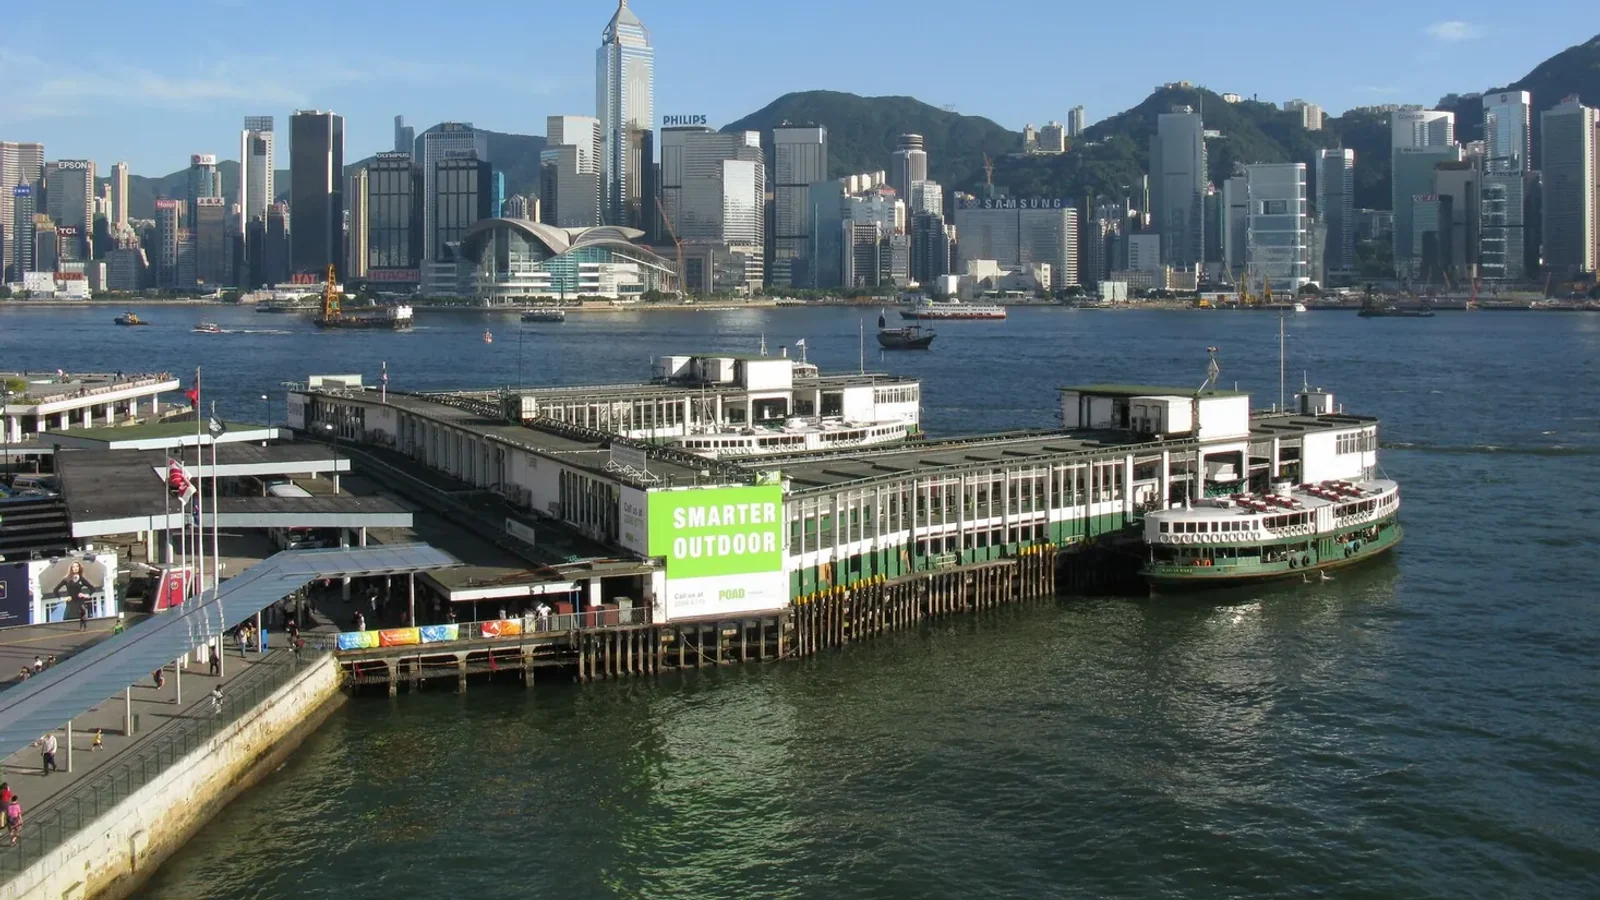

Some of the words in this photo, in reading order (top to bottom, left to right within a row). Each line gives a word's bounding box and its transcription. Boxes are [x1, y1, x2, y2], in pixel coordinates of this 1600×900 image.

[663, 115, 707, 125] PHILIPS
[58, 161, 87, 170] EPSON
[985, 198, 1061, 209] SAMSUNG
[59, 227, 77, 235] TCL
[367, 270, 418, 280] HITACHI
[673, 502, 776, 529] SMARTER
[673, 531, 776, 560] OUTDOOR
[674, 592, 687, 600] Call
[718, 588, 745, 602] POAD
